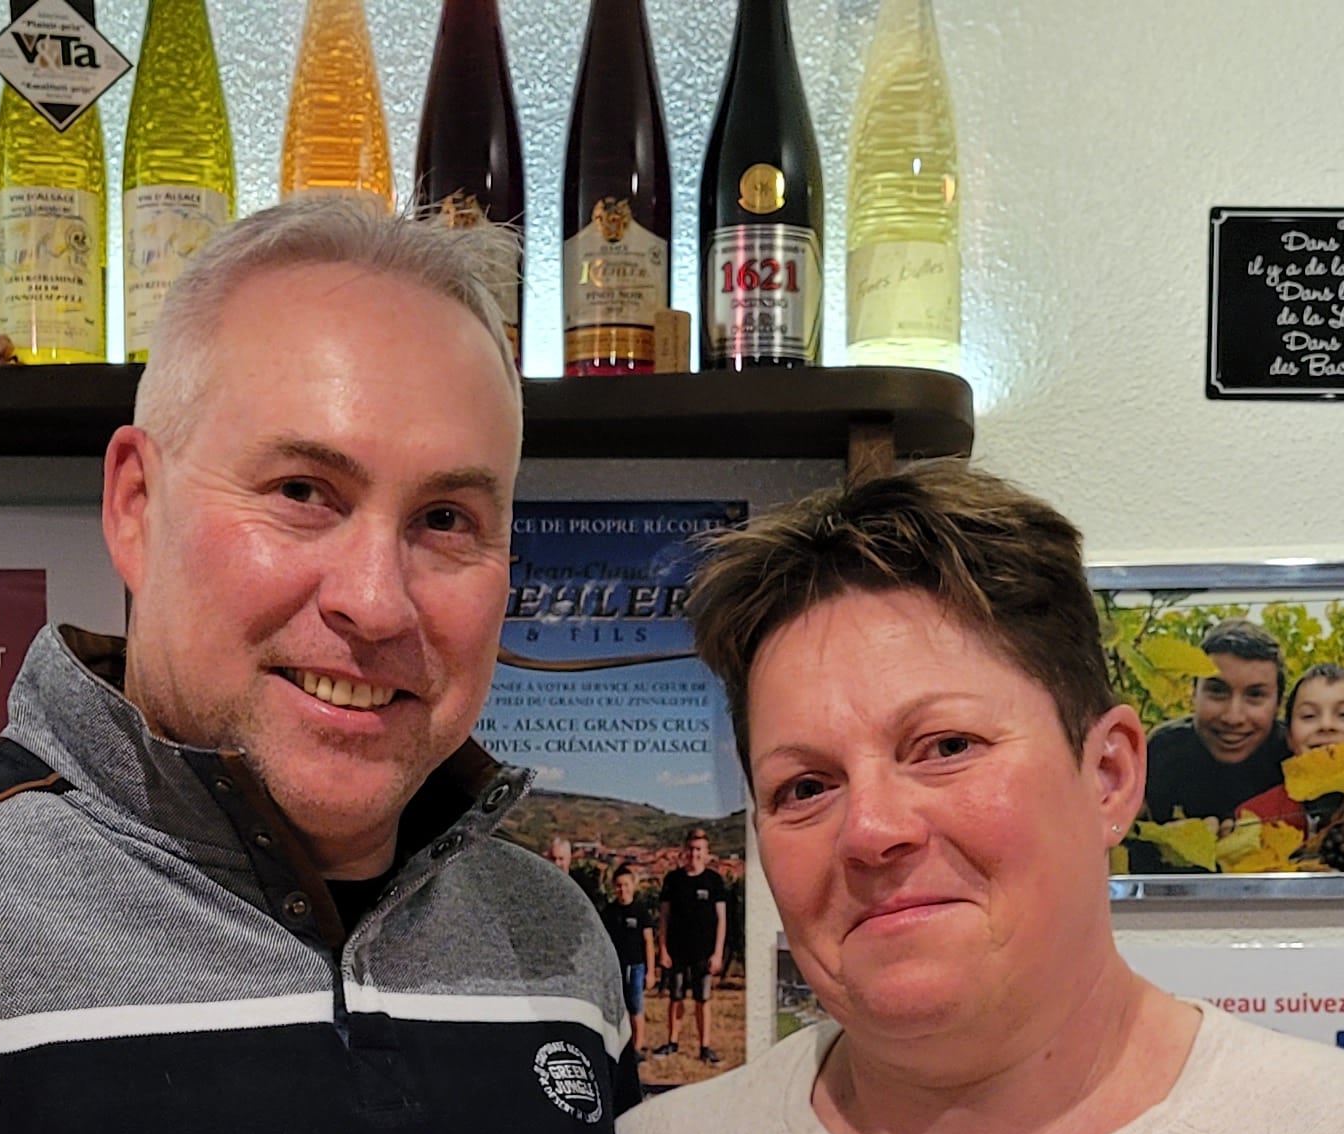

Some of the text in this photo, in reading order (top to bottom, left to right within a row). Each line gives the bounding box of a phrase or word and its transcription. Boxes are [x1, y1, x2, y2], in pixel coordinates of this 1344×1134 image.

[1281, 231, 1340, 252] Dans
[721, 258, 800, 293] 1621
[1247, 255, 1264, 275] il
[1265, 264, 1283, 287] y
[1286, 263, 1302, 276] a
[1305, 256, 1328, 275] de
[1276, 281, 1335, 301] Dans
[1276, 306, 1300, 326] de
[1303, 306, 1325, 326] la
[1282, 331, 1341, 351] Dans
[1269, 356, 1300, 375] des
[541, 519, 563, 533] DE
[568, 519, 637, 533] PROPRE
[570, 627, 648, 642] FILS
[514, 719, 710, 732] ALSACE GRANDS CRUS
[544, 735, 708, 752] CRÉMANT D'ALSACE
[548, 1065, 588, 1080] GREEN
